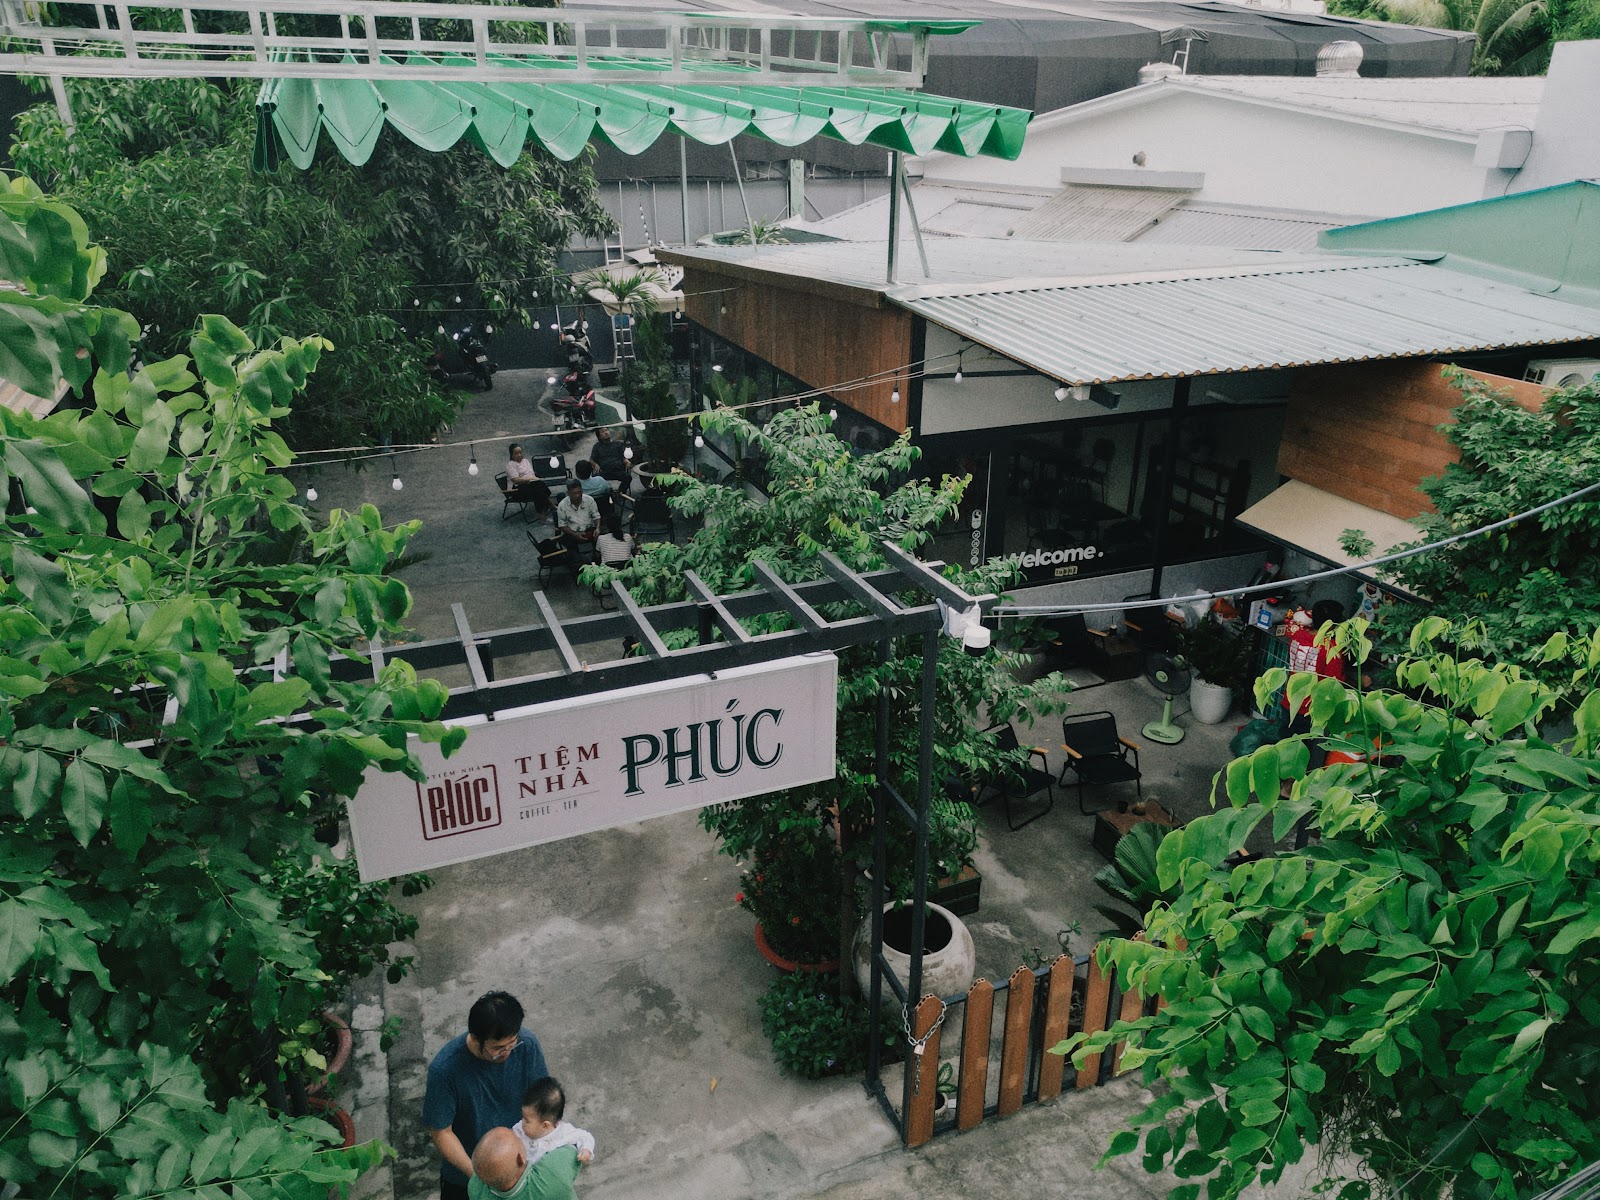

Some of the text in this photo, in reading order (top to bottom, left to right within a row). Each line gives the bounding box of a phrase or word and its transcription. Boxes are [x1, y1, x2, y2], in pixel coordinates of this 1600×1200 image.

[514, 742, 600, 774] TIỆM
[618, 698, 785, 798] PHÚC
[518, 766, 590, 799] NHÀ
[427, 774, 492, 832] PHÚC
[519, 799, 578, 820] COFFEE TEA
